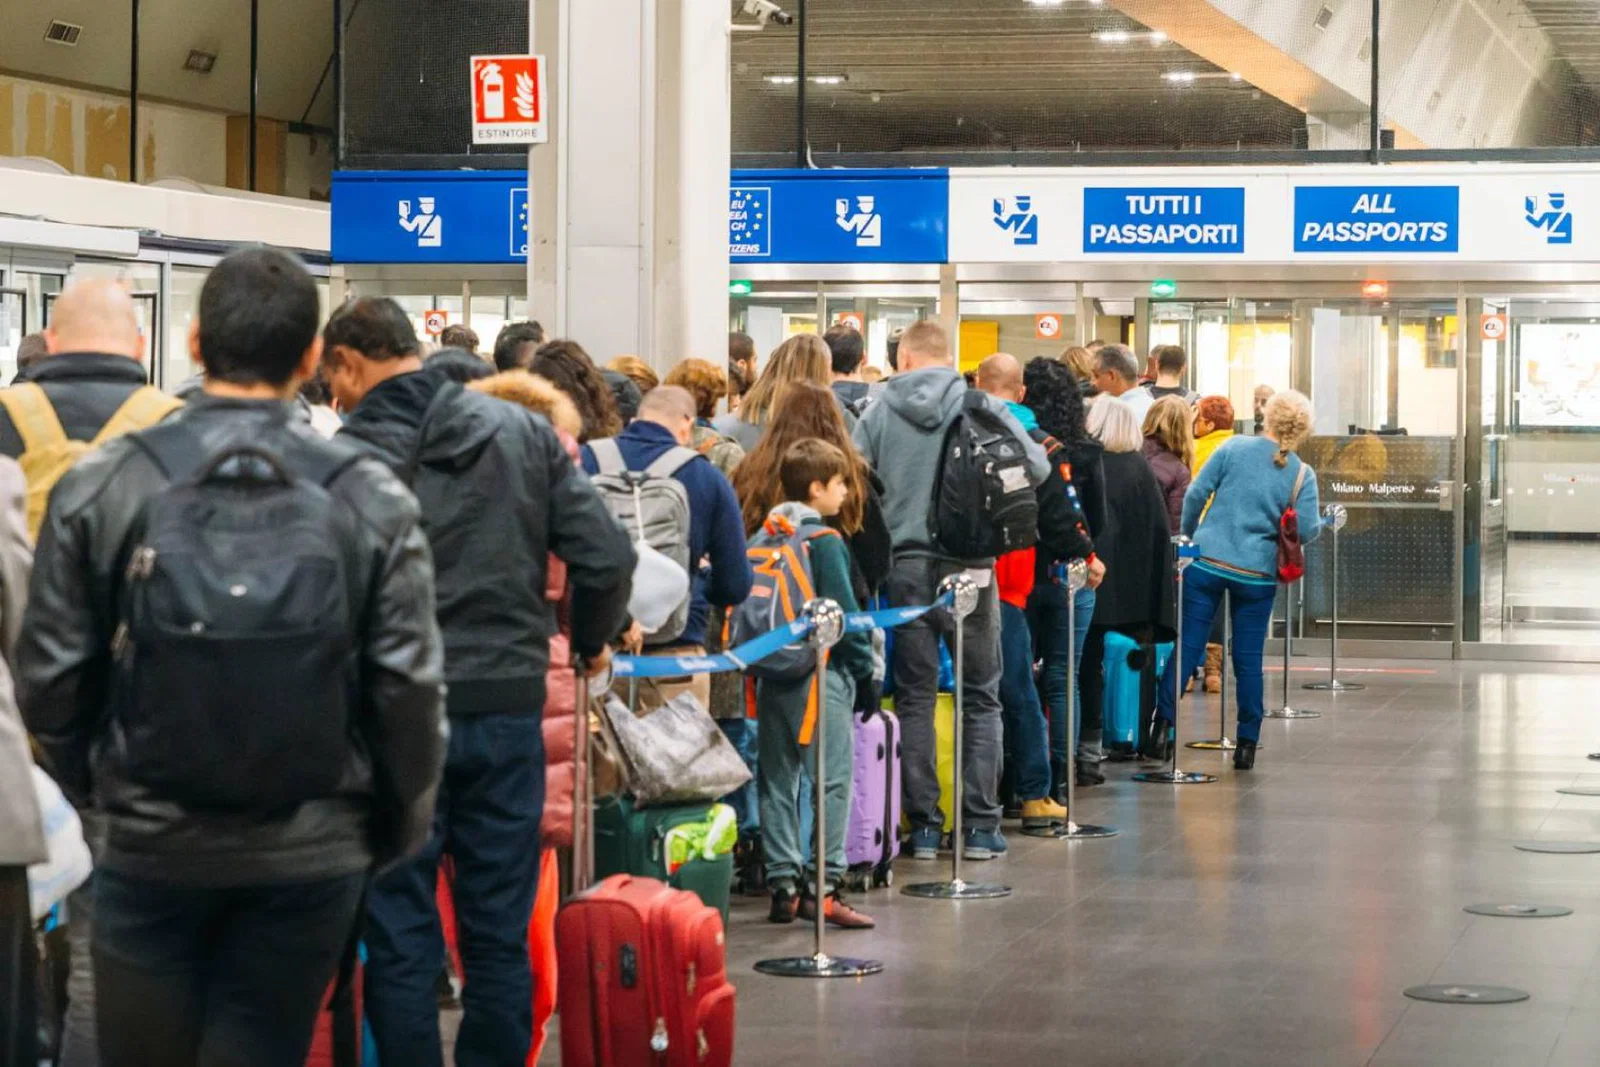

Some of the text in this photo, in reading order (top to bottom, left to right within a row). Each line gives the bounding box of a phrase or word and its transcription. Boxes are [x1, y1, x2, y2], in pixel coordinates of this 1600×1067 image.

[478, 128, 538, 138] ESTINTORE
[731, 199, 746, 209] EU
[1126, 195, 1202, 215] TUTTI I
[1351, 193, 1397, 214] ALL
[731, 222, 746, 231] CH
[1089, 223, 1238, 244] PASSAPORTI
[1302, 221, 1449, 242] PASSPORTS
[1331, 482, 1364, 493] Milano
